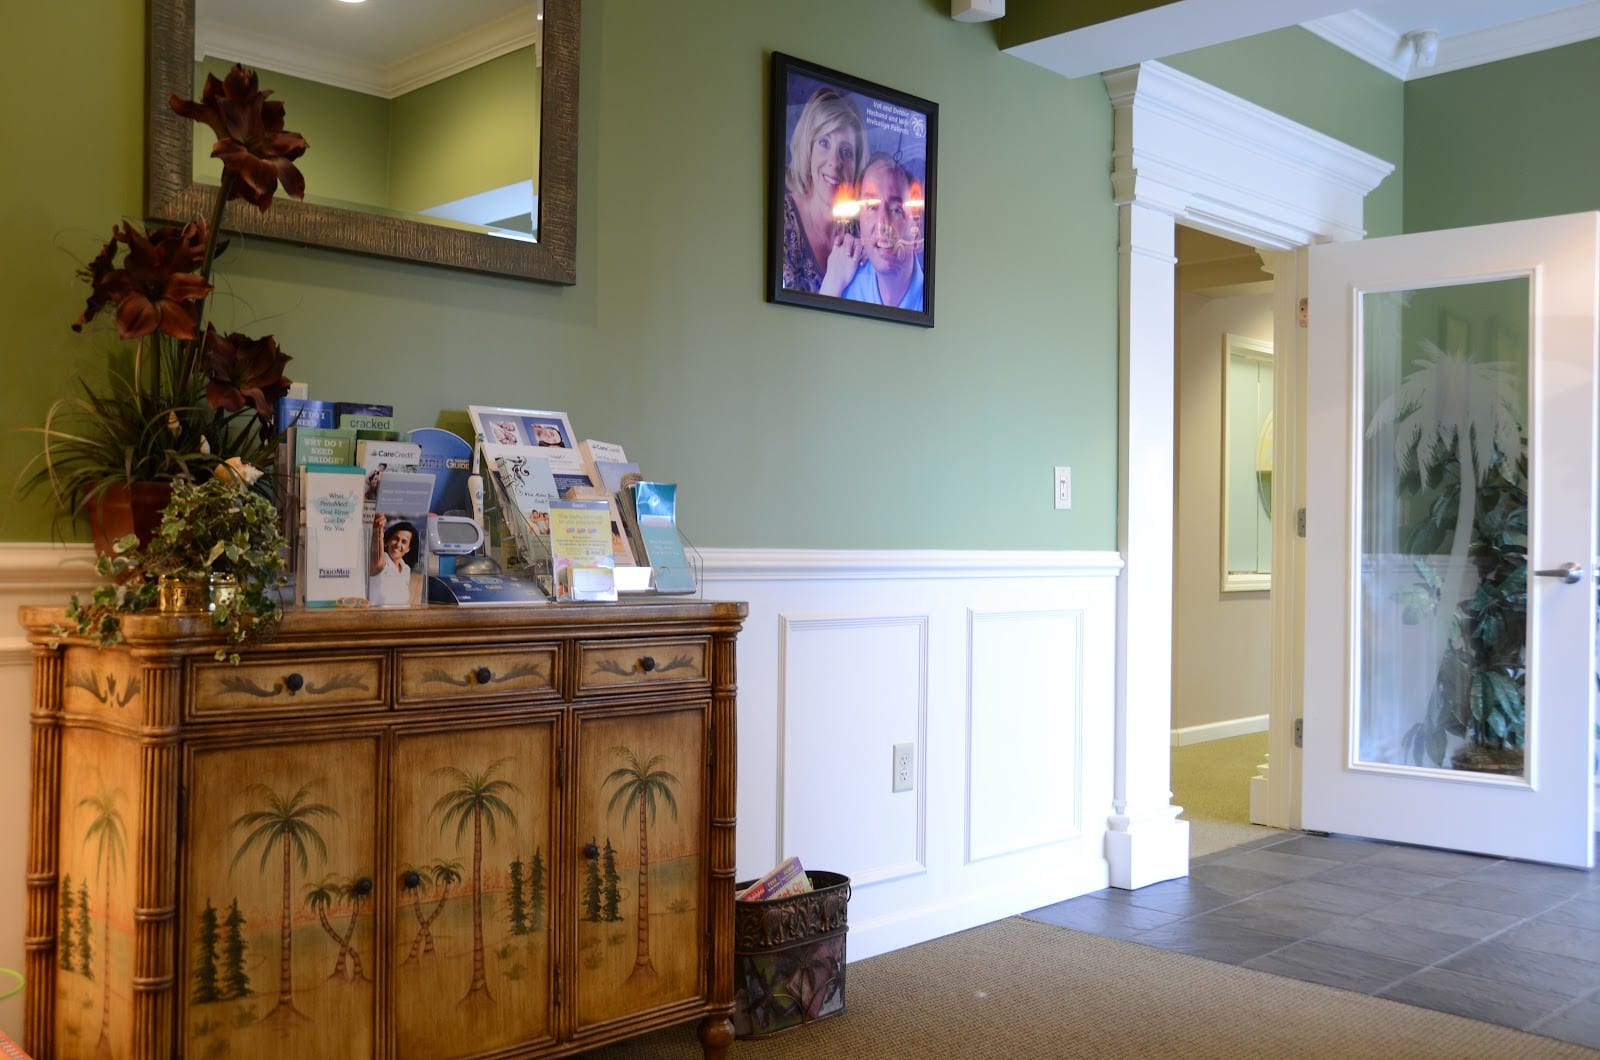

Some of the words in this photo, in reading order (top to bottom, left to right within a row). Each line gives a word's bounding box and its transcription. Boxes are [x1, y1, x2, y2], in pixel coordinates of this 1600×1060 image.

[866, 107, 888, 120] Husband
[350, 418, 391, 430] cracked
[304, 438, 322, 447] WHY
[324, 439, 337, 448] DO
[339, 440, 343, 448] I
[311, 447, 334, 456] NEED
[378, 450, 415, 459] CareCredit
